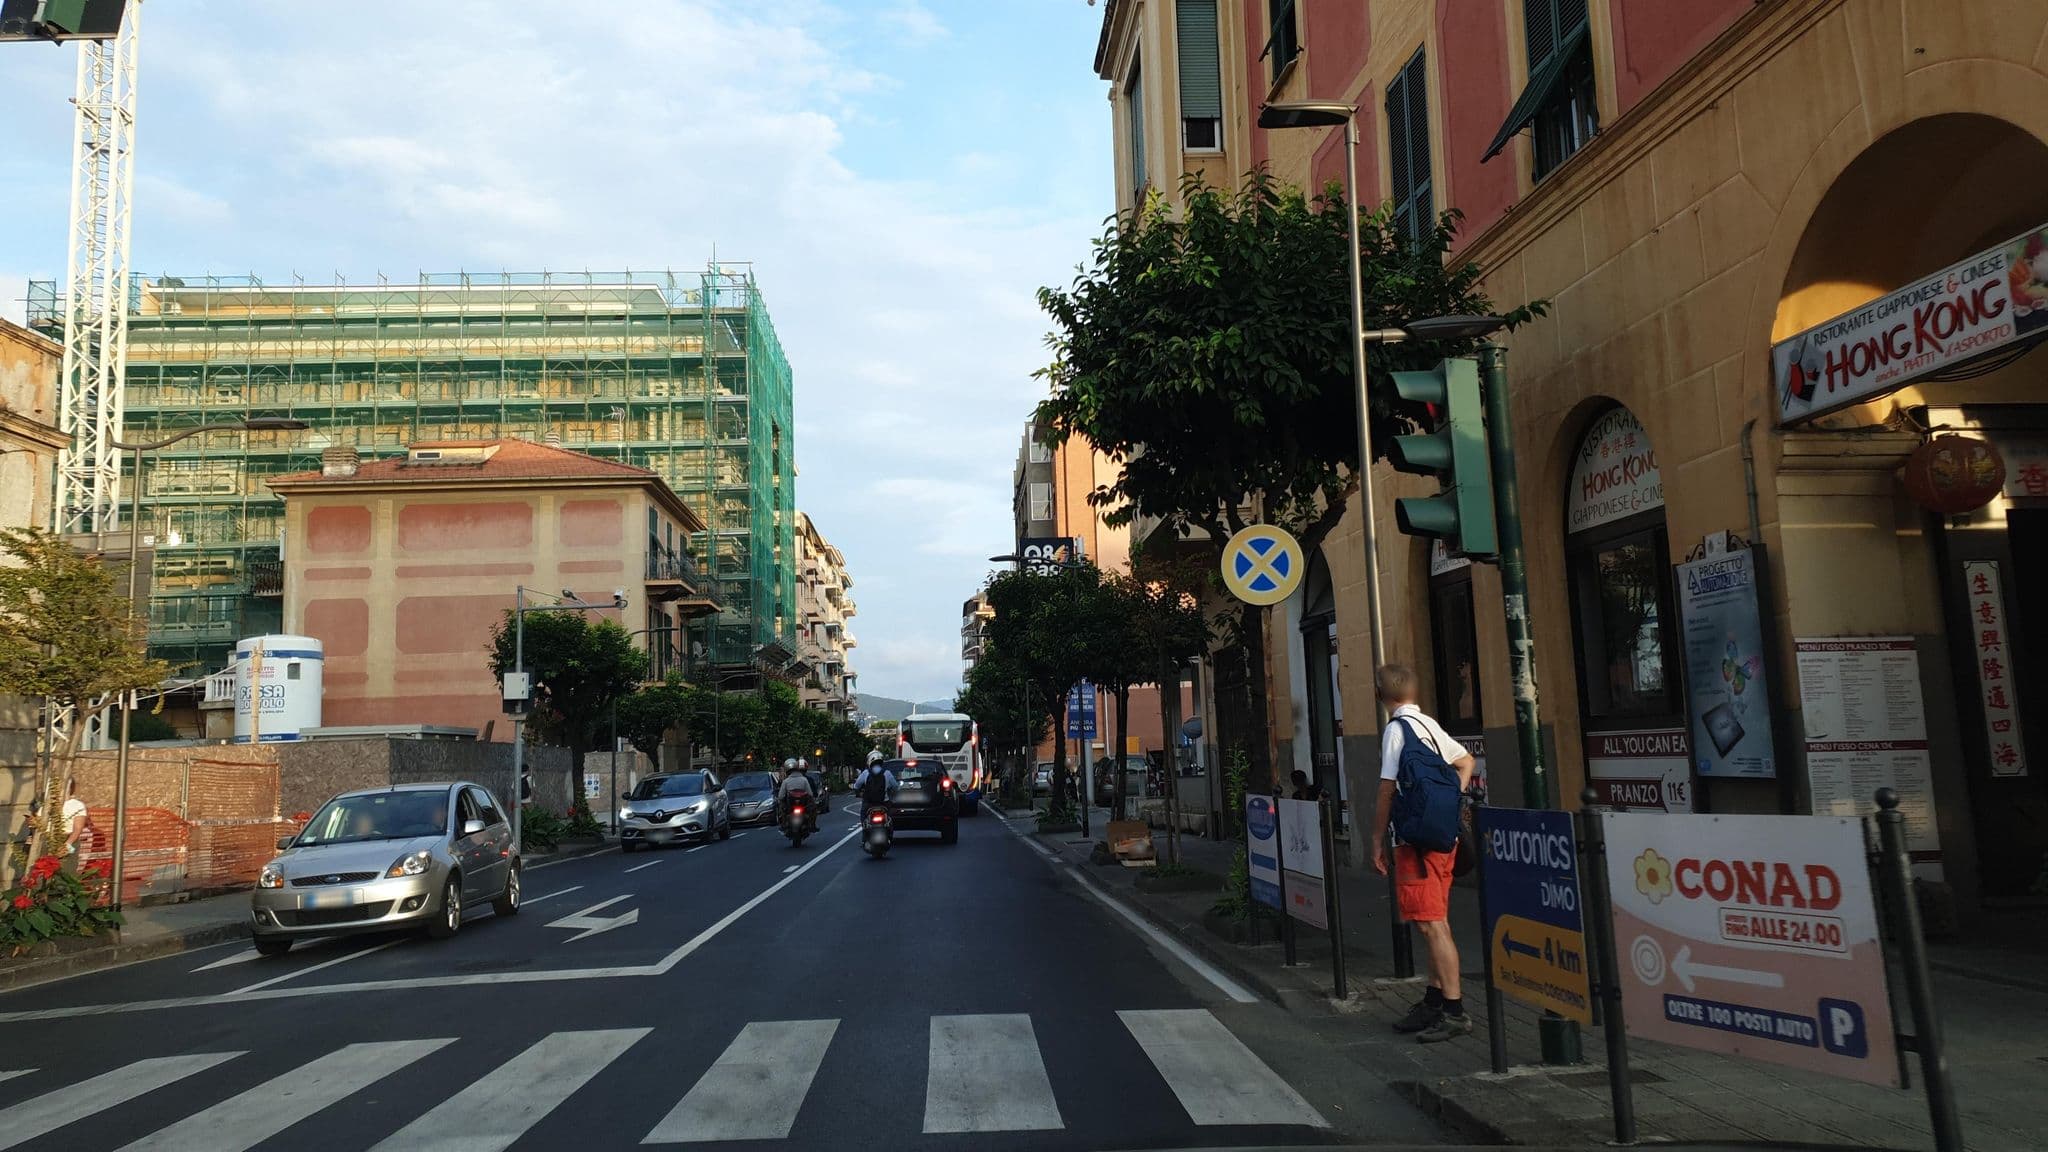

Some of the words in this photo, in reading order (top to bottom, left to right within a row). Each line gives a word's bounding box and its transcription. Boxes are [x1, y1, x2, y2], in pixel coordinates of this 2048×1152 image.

[1813, 309, 1874, 347] RISTORANTE
[1876, 280, 1945, 320] GIAPPONESE
[1946, 270, 1960, 294] &
[1960, 253, 2004, 285] CINESE
[1825, 323, 1913, 393] HONG
[1913, 279, 2007, 354] KONG
[1904, 352, 1935, 373] PIATTI
[1581, 410, 1644, 464] RISTORAN
[1583, 465, 1622, 502] HONG
[1573, 494, 1631, 525] GIAPPONESE
[1024, 544, 1054, 564] Q8
[1698, 559, 1745, 578] PROGETTO
[1798, 642, 1821, 651] MENU
[1822, 642, 1845, 651] FISSO
[1603, 737, 1623, 754] ALL
[1622, 736, 1645, 754] YOU
[1646, 735, 1670, 753] CAN
[1809, 743, 1832, 751] MENU
[1833, 743, 1857, 751] FISSO
[1610, 784, 1658, 804] PRANZO
[1492, 822, 1571, 870] euronics
[1540, 881, 1576, 912] DIMO
[1675, 858, 1842, 911] CONAD
[1751, 916, 1789, 941] ALLE
[1544, 936, 1554, 966] 4
[1556, 939, 1582, 975] km
[1667, 999, 1704, 1021] OLTRE
[1706, 1005, 1732, 1025] 100
[1734, 1009, 1774, 1033] POSTI
[1776, 1017, 1814, 1041] AUTO
[1828, 1006, 1855, 1047] P
